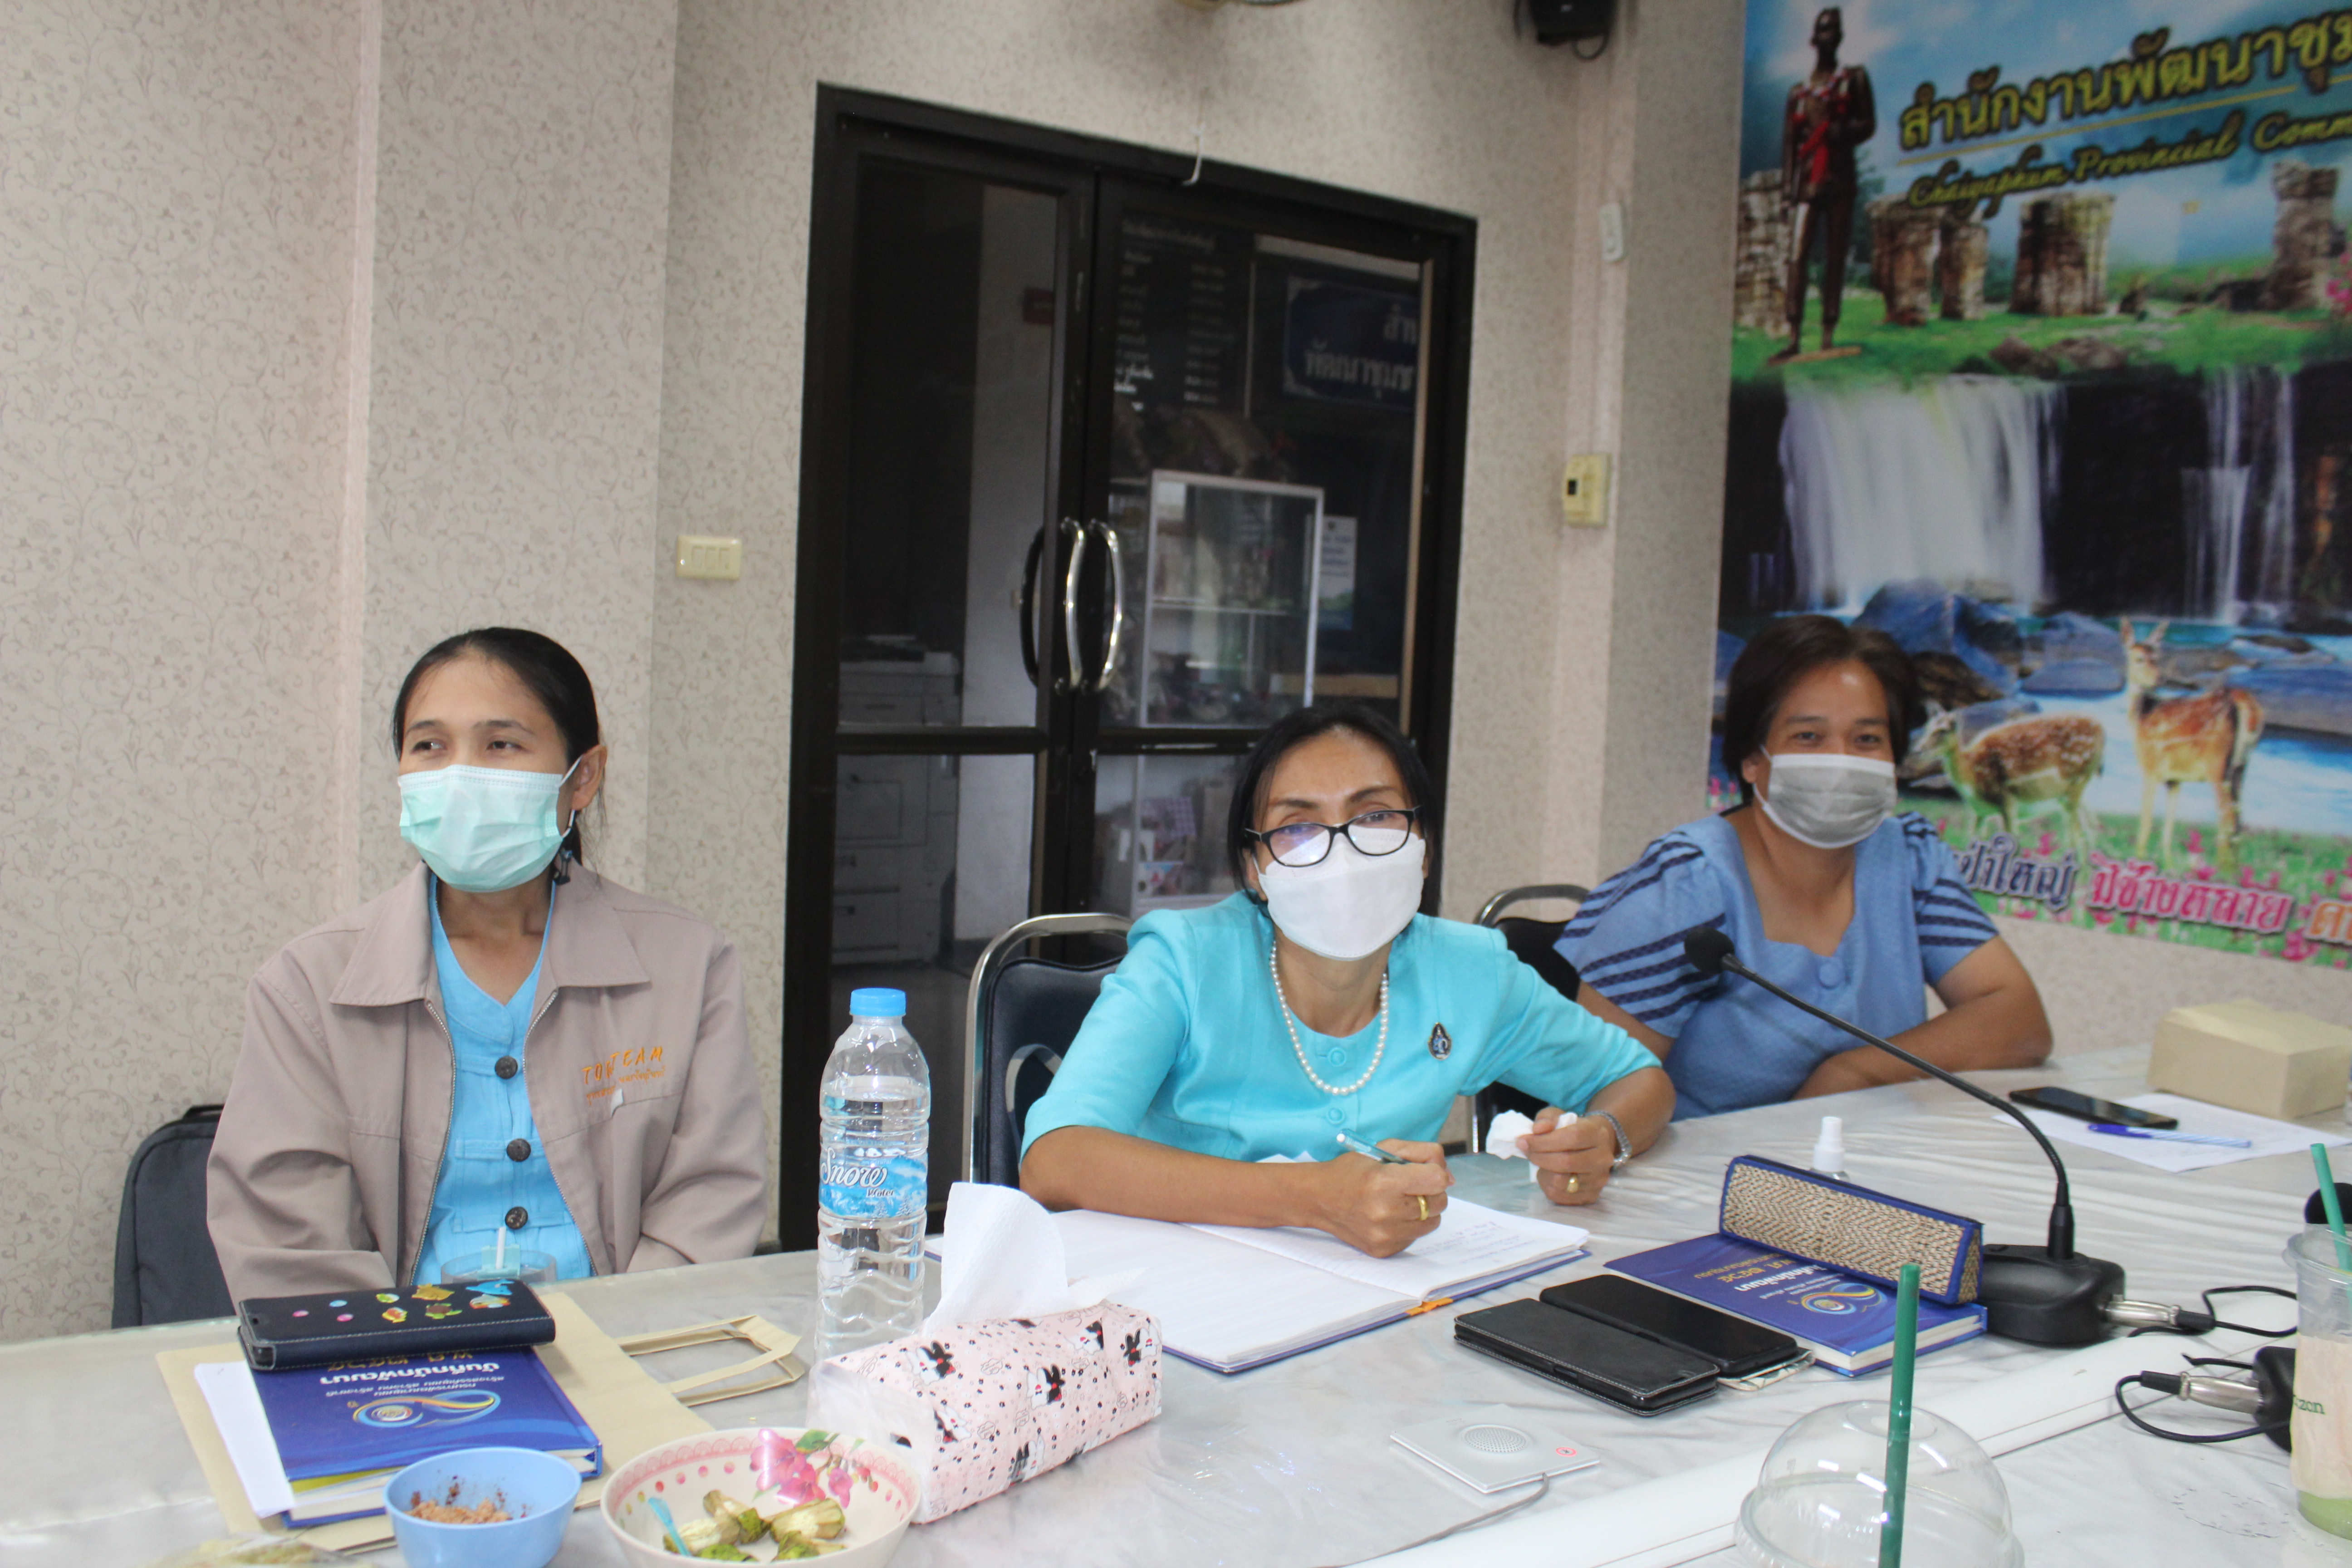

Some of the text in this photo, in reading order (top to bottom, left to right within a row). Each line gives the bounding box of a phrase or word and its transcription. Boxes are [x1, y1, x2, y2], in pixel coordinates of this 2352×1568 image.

[2073, 109, 2245, 181] Provincial
[610, 1046, 663, 1071] TEAM
[821, 1147, 888, 1187] Snow
[867, 1188, 895, 1197] Water
[319, 1362, 500, 1385] บันทึกนักพัฒนา
[2293, 1396, 2325, 1414] zon
